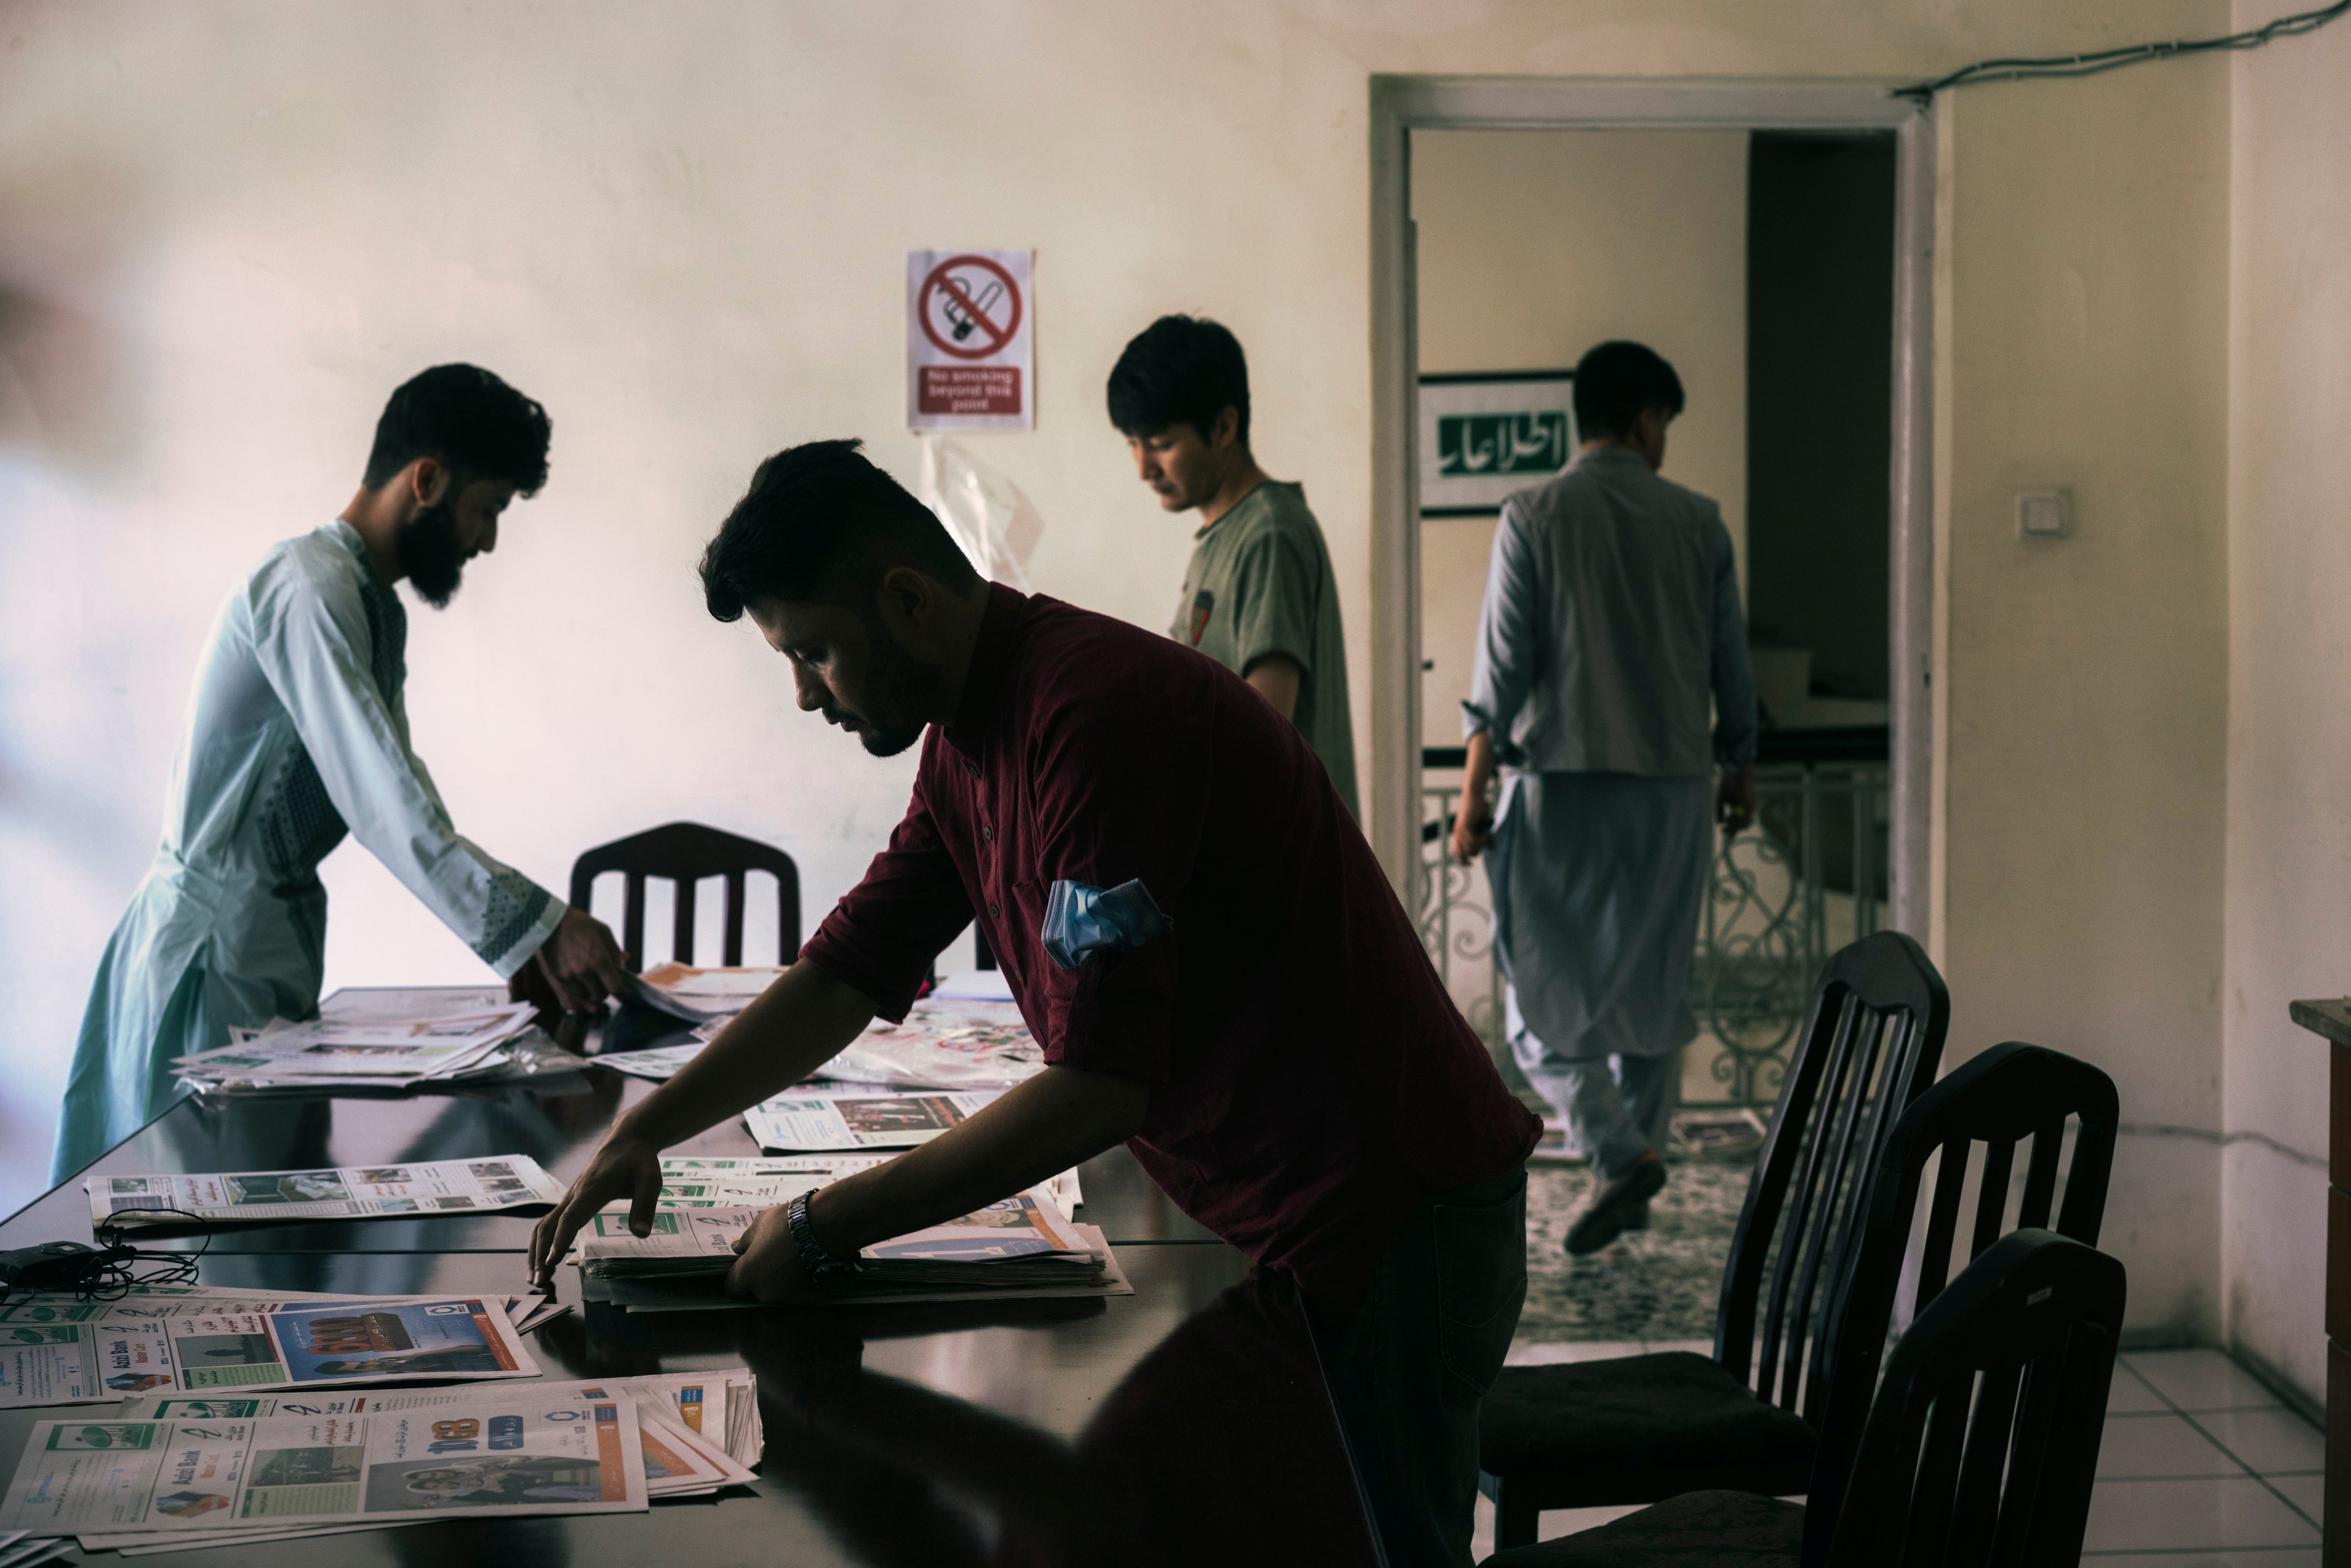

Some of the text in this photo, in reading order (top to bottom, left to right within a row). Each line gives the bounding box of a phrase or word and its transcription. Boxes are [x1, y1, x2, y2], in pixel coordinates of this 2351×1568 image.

[951, 370, 1013, 384] smoking
[928, 384, 982, 398] beyond
[952, 398, 989, 412] point
[307, 1316, 373, 1355] 6000
[109, 1340, 131, 1369] Azizi Bank
[135, 1352, 148, 1363] Master
[426, 1418, 480, 1455] 10GB
[172, 1450, 201, 1485] Azizi Bank
